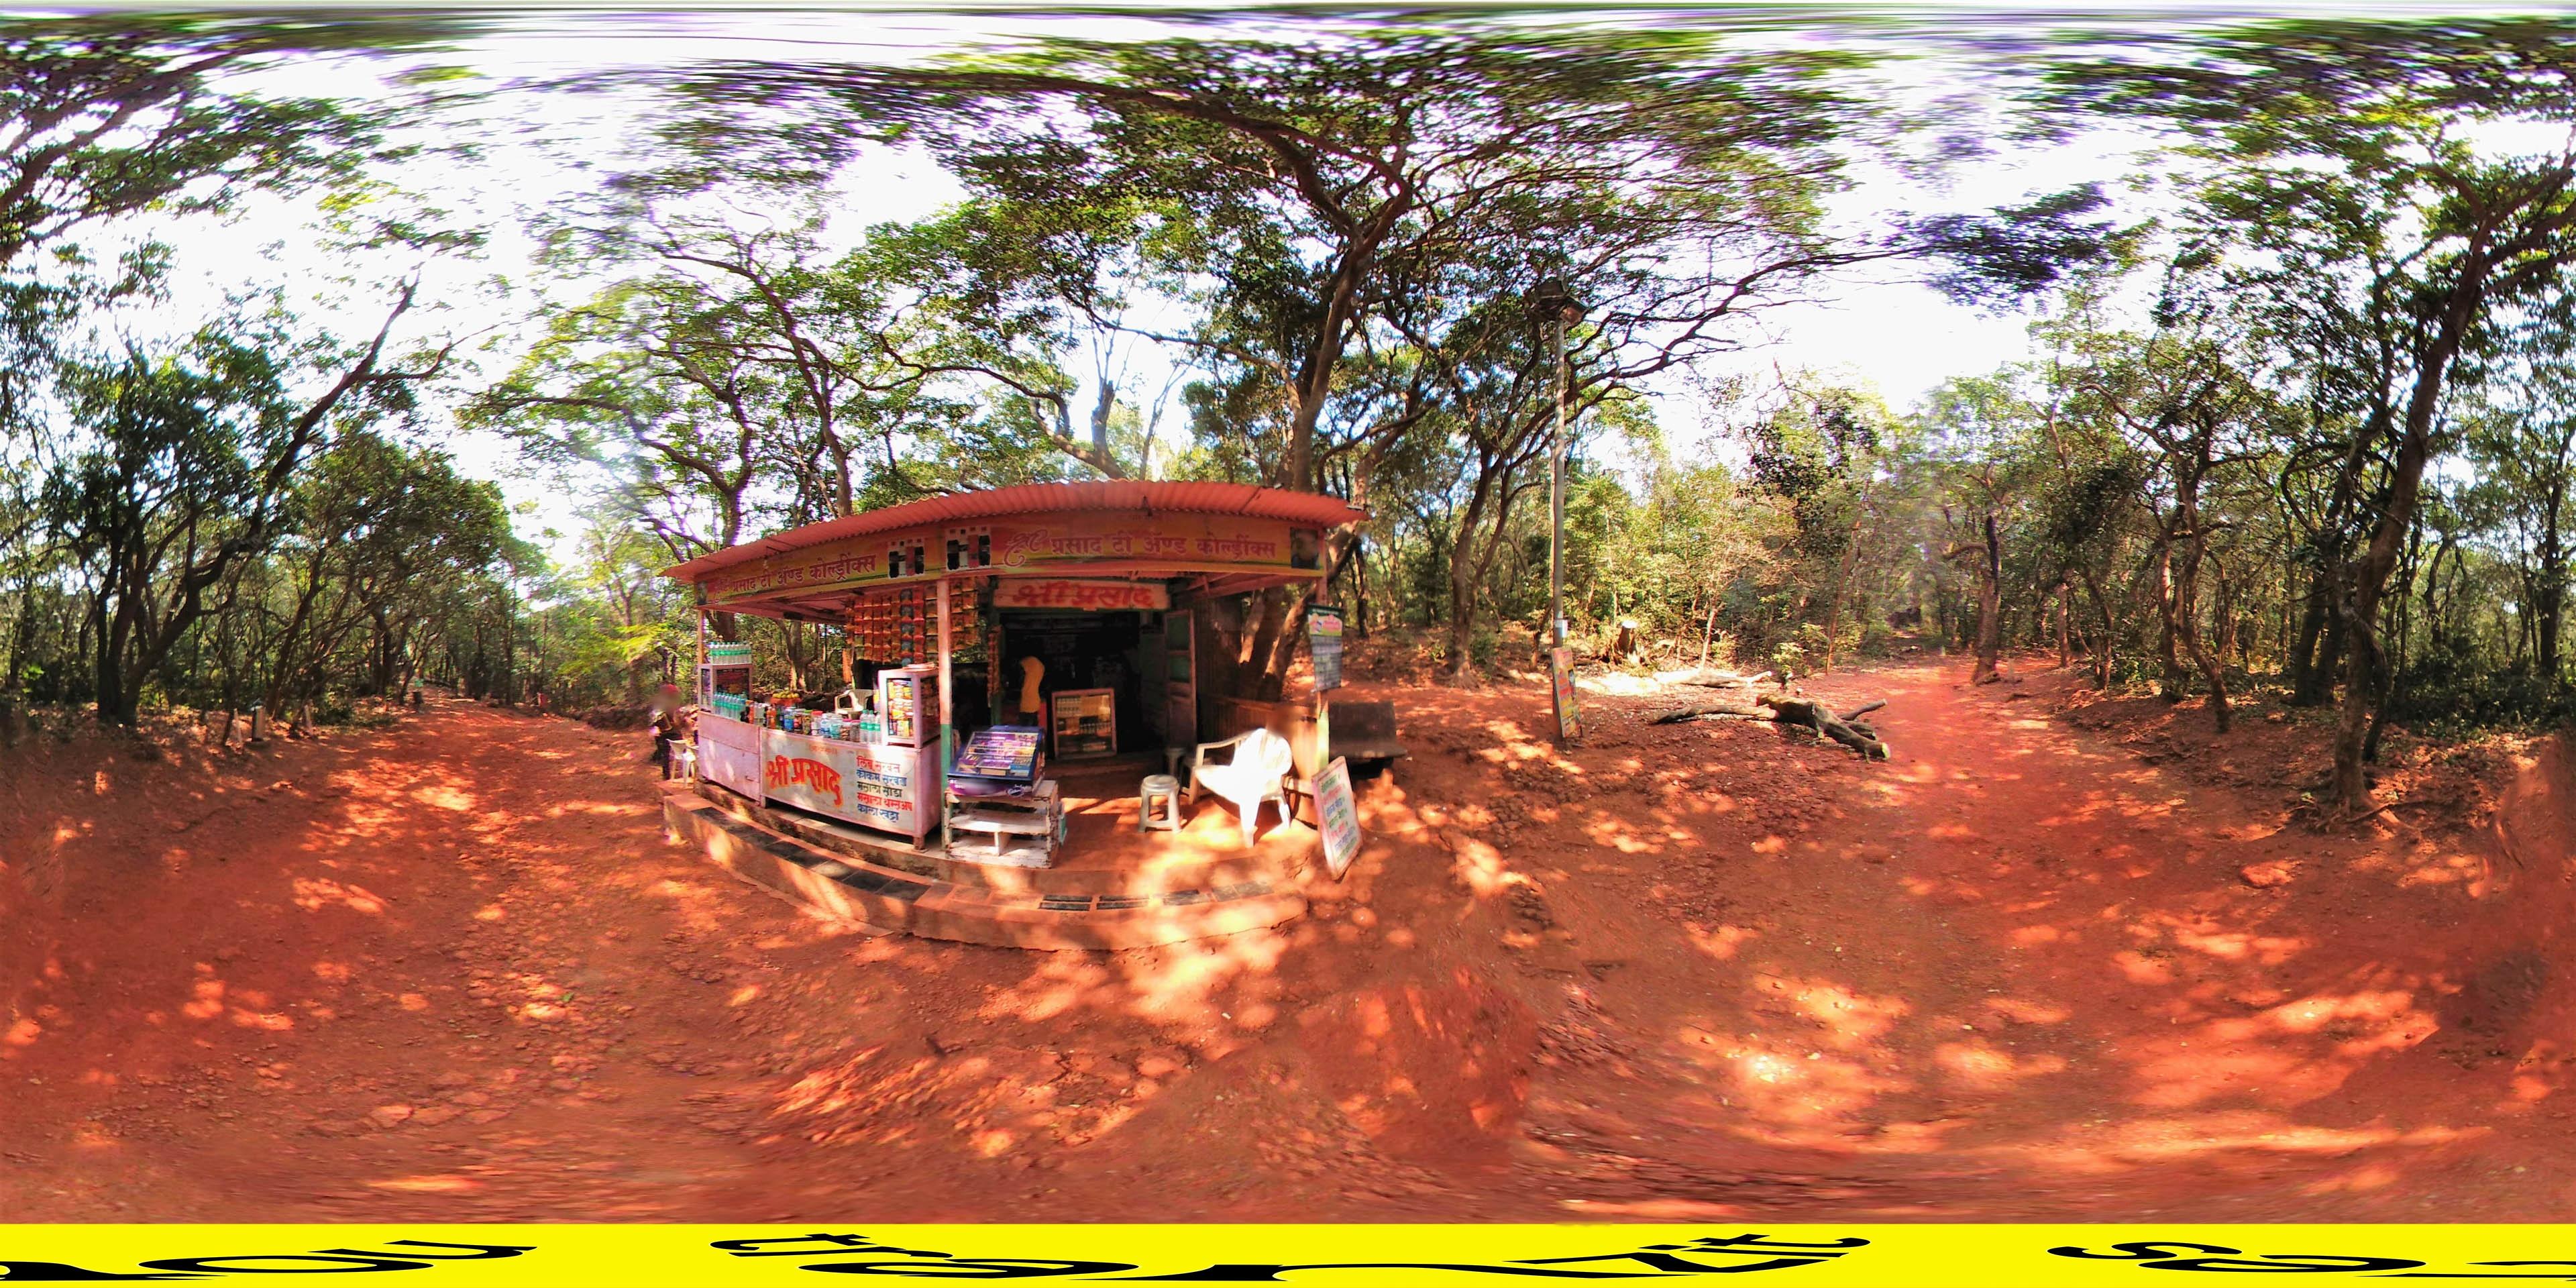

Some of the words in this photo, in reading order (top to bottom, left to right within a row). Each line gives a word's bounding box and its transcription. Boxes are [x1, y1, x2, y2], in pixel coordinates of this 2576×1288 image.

[1051, 537, 1104, 556] प्रसाद
[1112, 529, 1133, 555] टी
[760, 568, 772, 588] टी
[765, 755, 790, 790] श्री
[790, 758, 844, 808] प्रसाद
